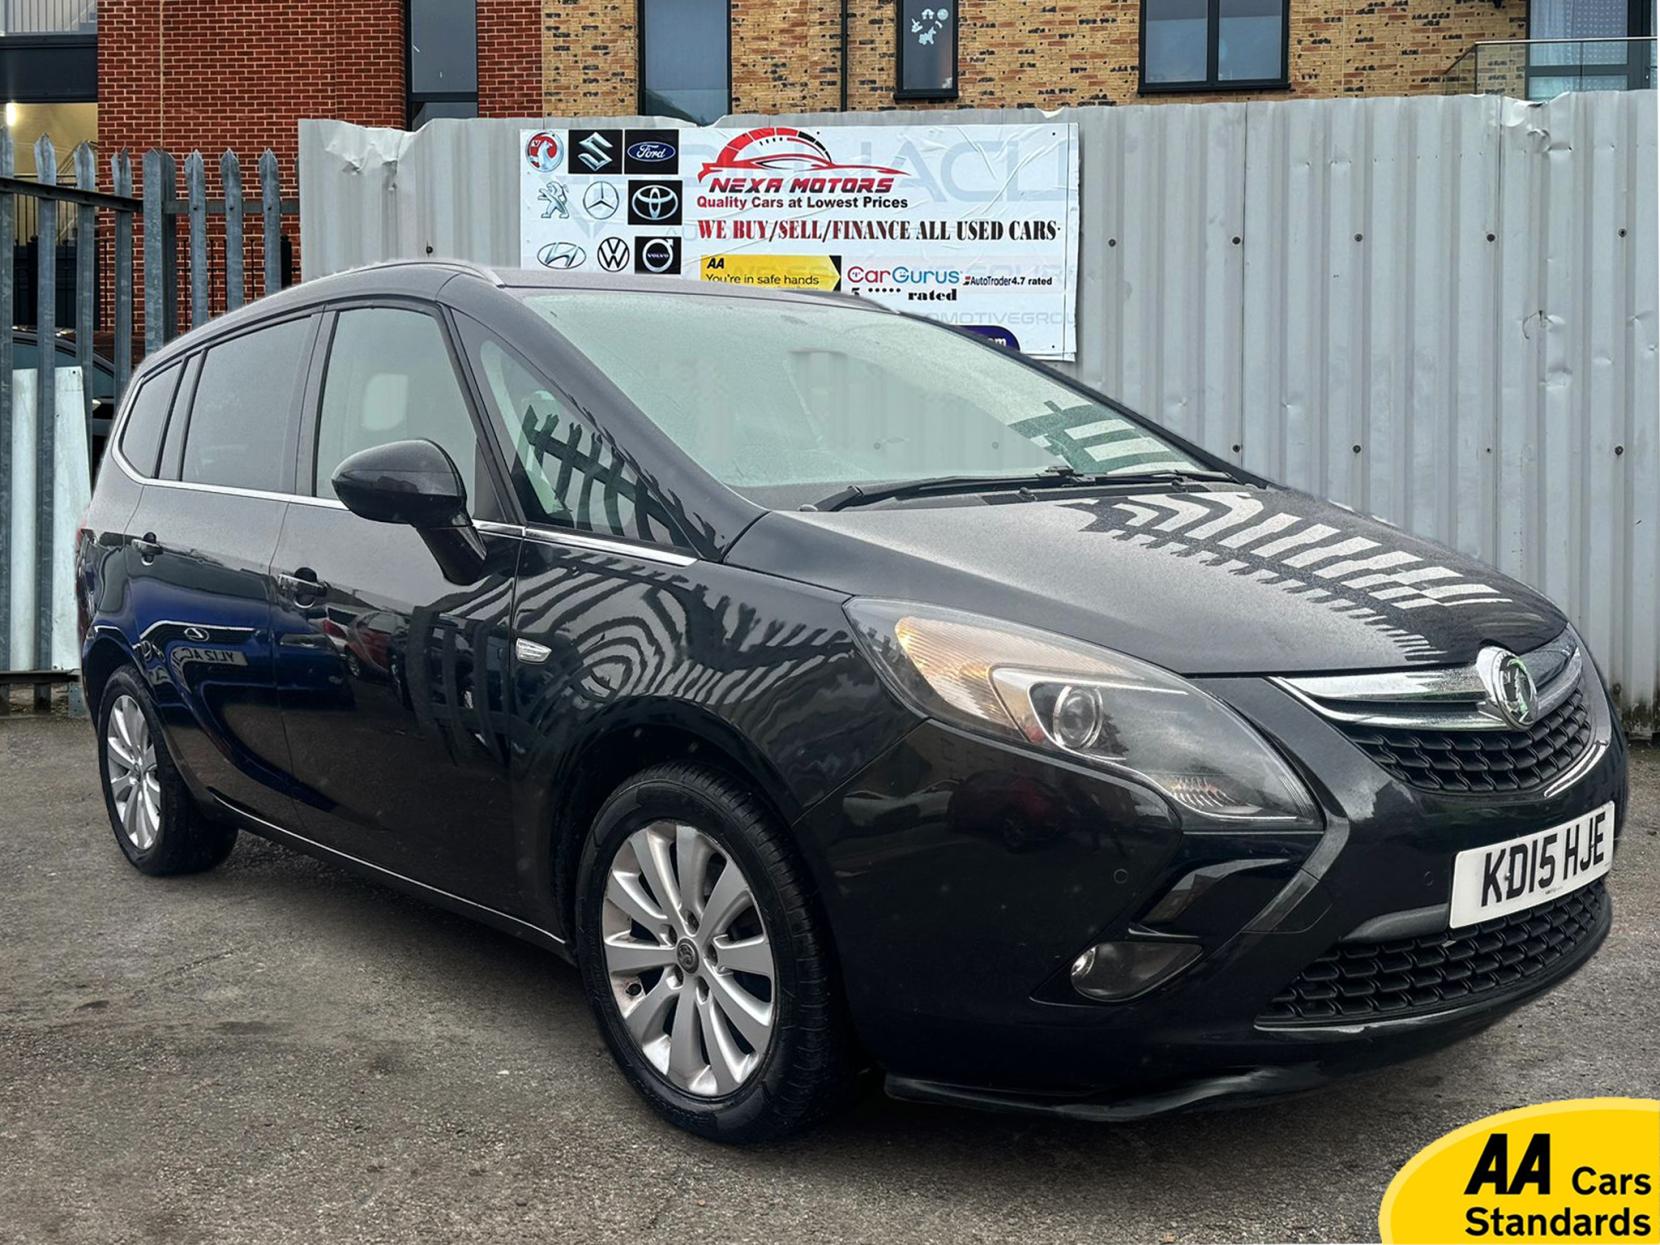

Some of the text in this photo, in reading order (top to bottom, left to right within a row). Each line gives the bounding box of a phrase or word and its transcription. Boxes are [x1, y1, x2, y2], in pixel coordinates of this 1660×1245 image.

[636, 144, 667, 159] Ford
[709, 178, 895, 194] NEXA MOTORS
[697, 196, 908, 209] Quality Cars at Lowest Prices
[698, 220, 727, 240] WE
[733, 219, 910, 243] BUY/SELL/FINANCE
[916, 220, 951, 241] ALL
[957, 220, 1004, 241] USED
[1008, 220, 1057, 241] CARS
[707, 257, 725, 270] AA
[706, 273, 820, 286] You're in safe hands
[847, 266, 960, 284] CarGurus
[1028, 276, 1053, 286] rated
[908, 288, 957, 301] rated
[1481, 812, 1606, 907] KD15 HJE
